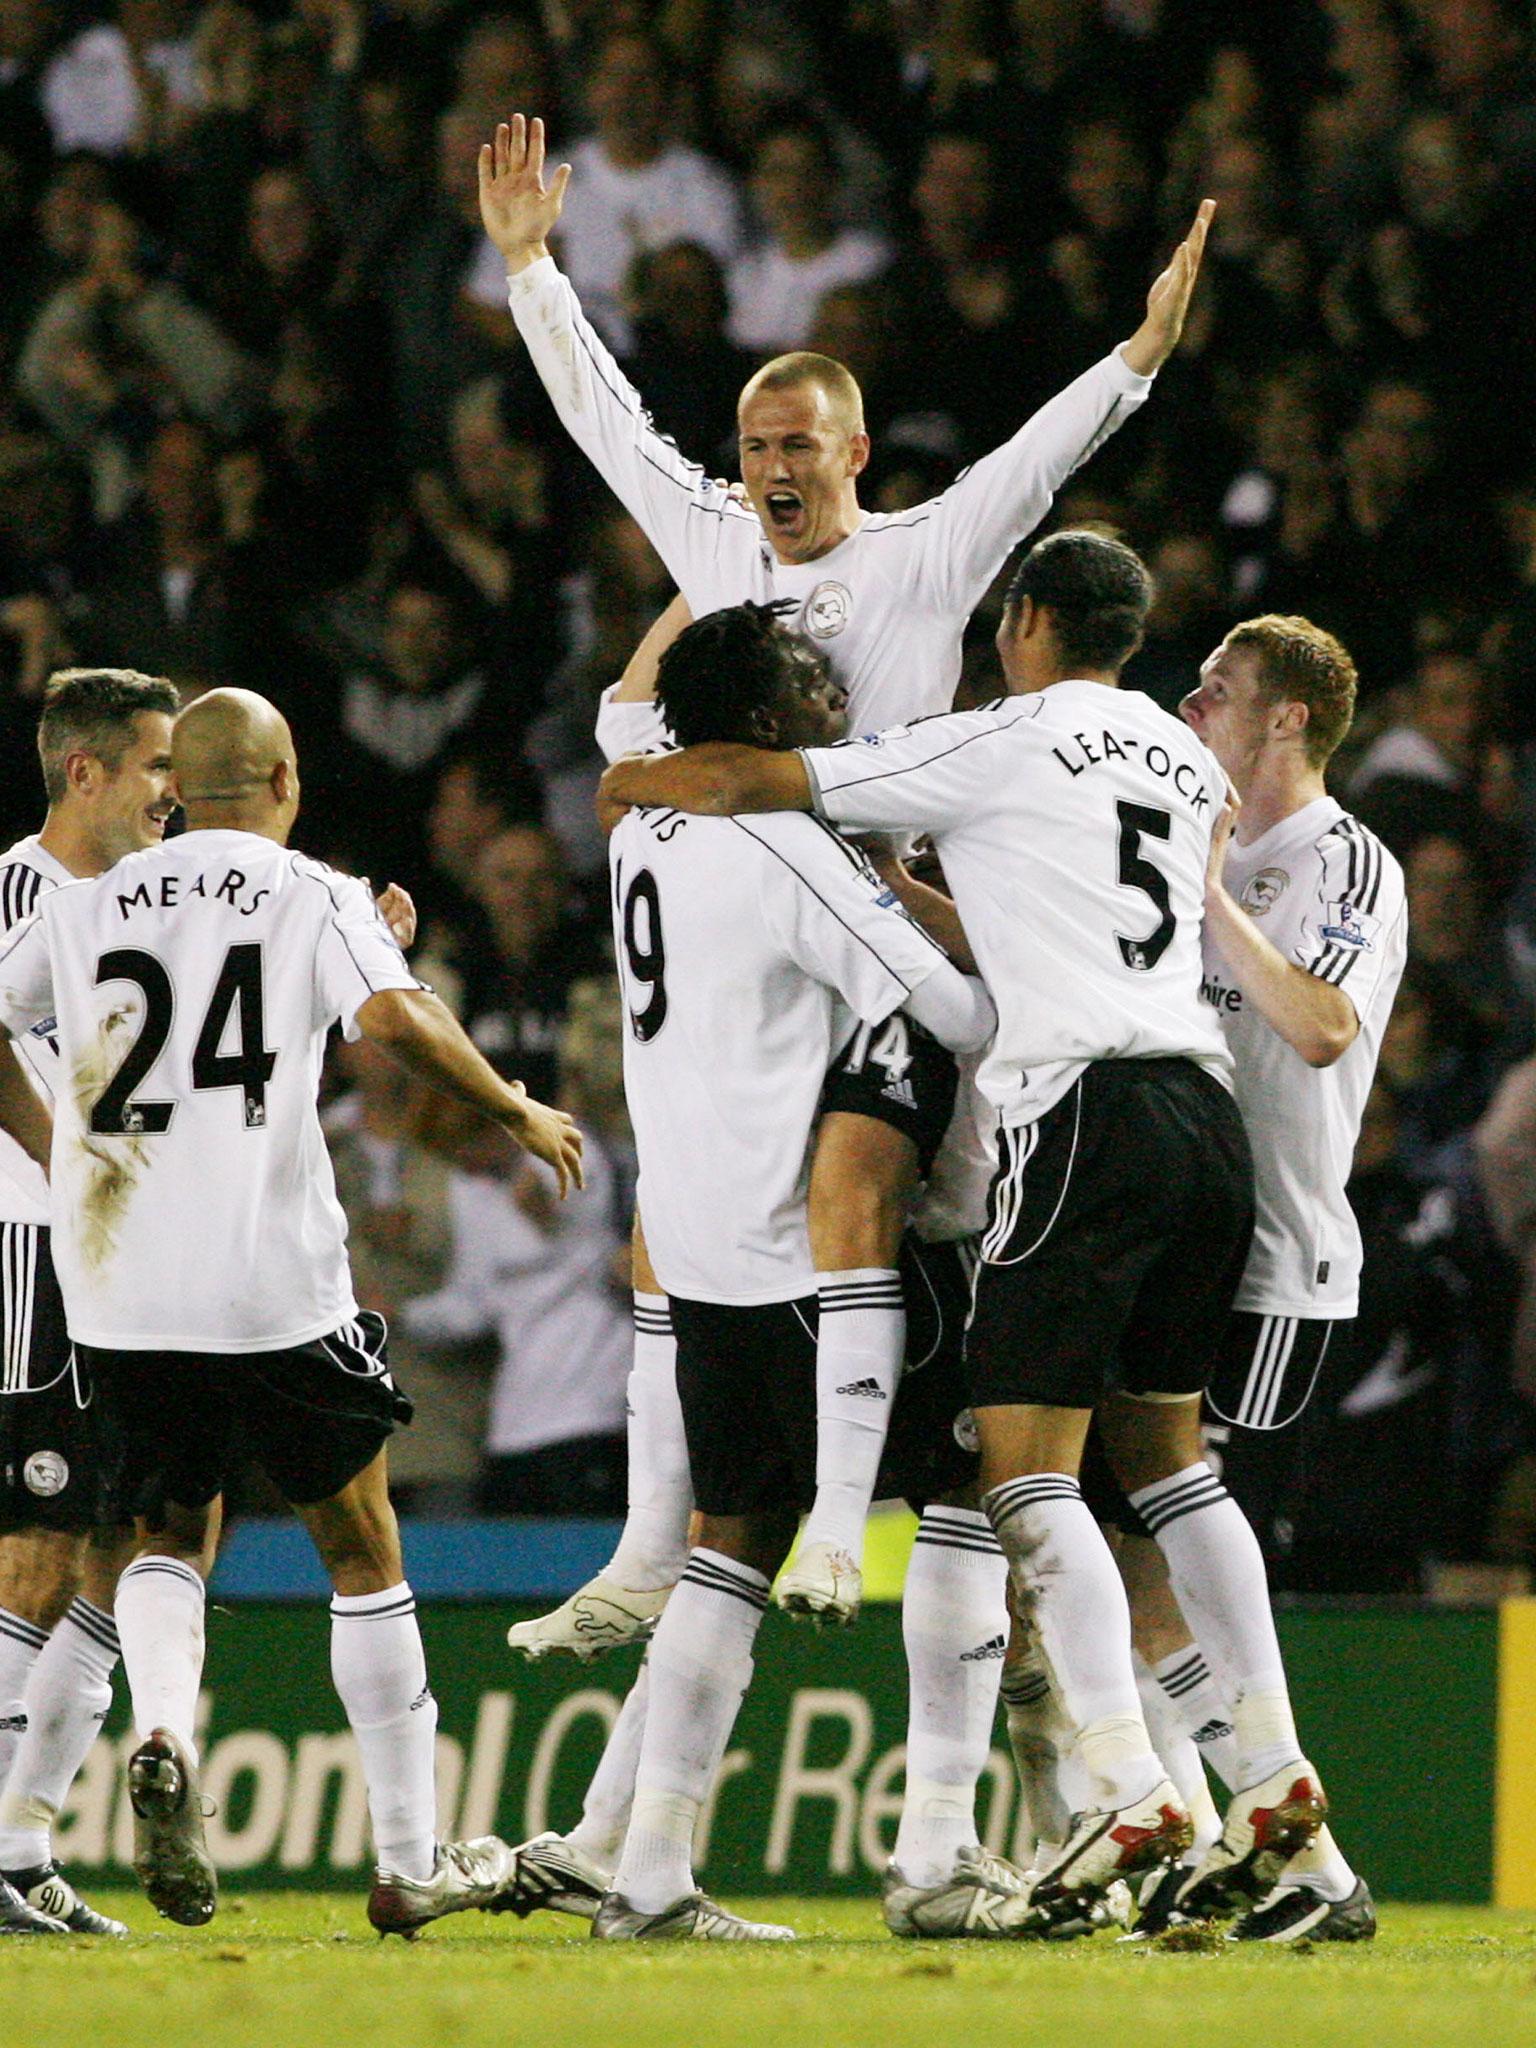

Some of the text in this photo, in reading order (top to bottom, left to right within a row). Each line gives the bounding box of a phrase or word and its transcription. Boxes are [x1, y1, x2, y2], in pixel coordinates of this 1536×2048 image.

[116, 868, 270, 921] MEARS
[1114, 795, 1177, 974] 5
[88, 939, 281, 1136] 24
[842, 1016, 914, 1082] 14
[525, 1690, 752, 1872] Cr
[41, 1886, 65, 1915] 90
